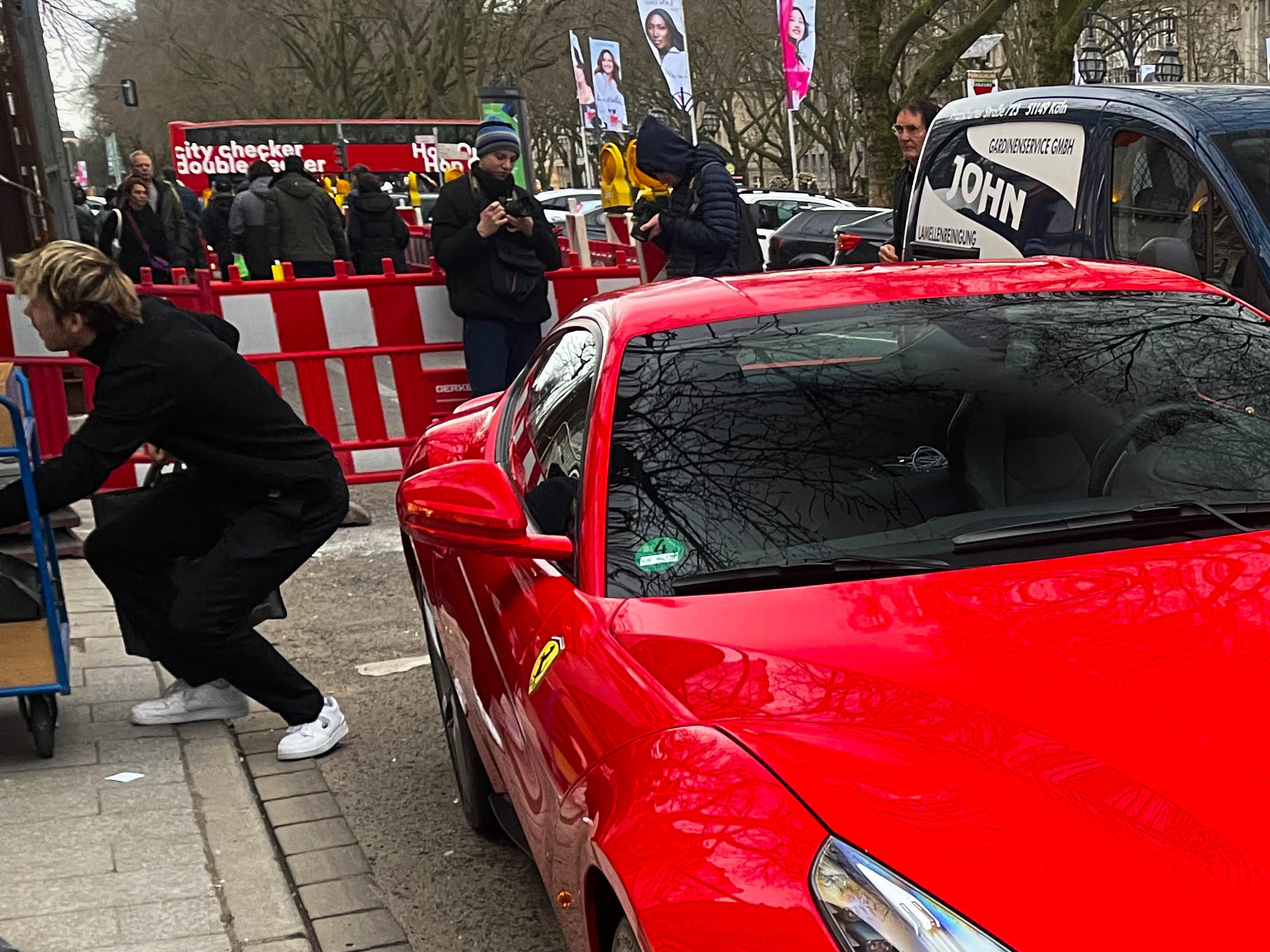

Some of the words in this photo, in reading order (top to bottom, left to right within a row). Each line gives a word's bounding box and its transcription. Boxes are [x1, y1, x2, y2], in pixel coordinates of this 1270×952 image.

[1025, 102, 1049, 116] 51149
[1048, 100, 1069, 115] Köln
[174, 141, 212, 160] city
[218, 139, 304, 159] checker
[988, 138, 1050, 154] GARDINENSERVICE
[1051, 139, 1076, 155] GMBH
[177, 155, 249, 175] double
[946, 154, 1027, 231] JOHN
[918, 225, 977, 246] LAMELLENREINIGUNG
